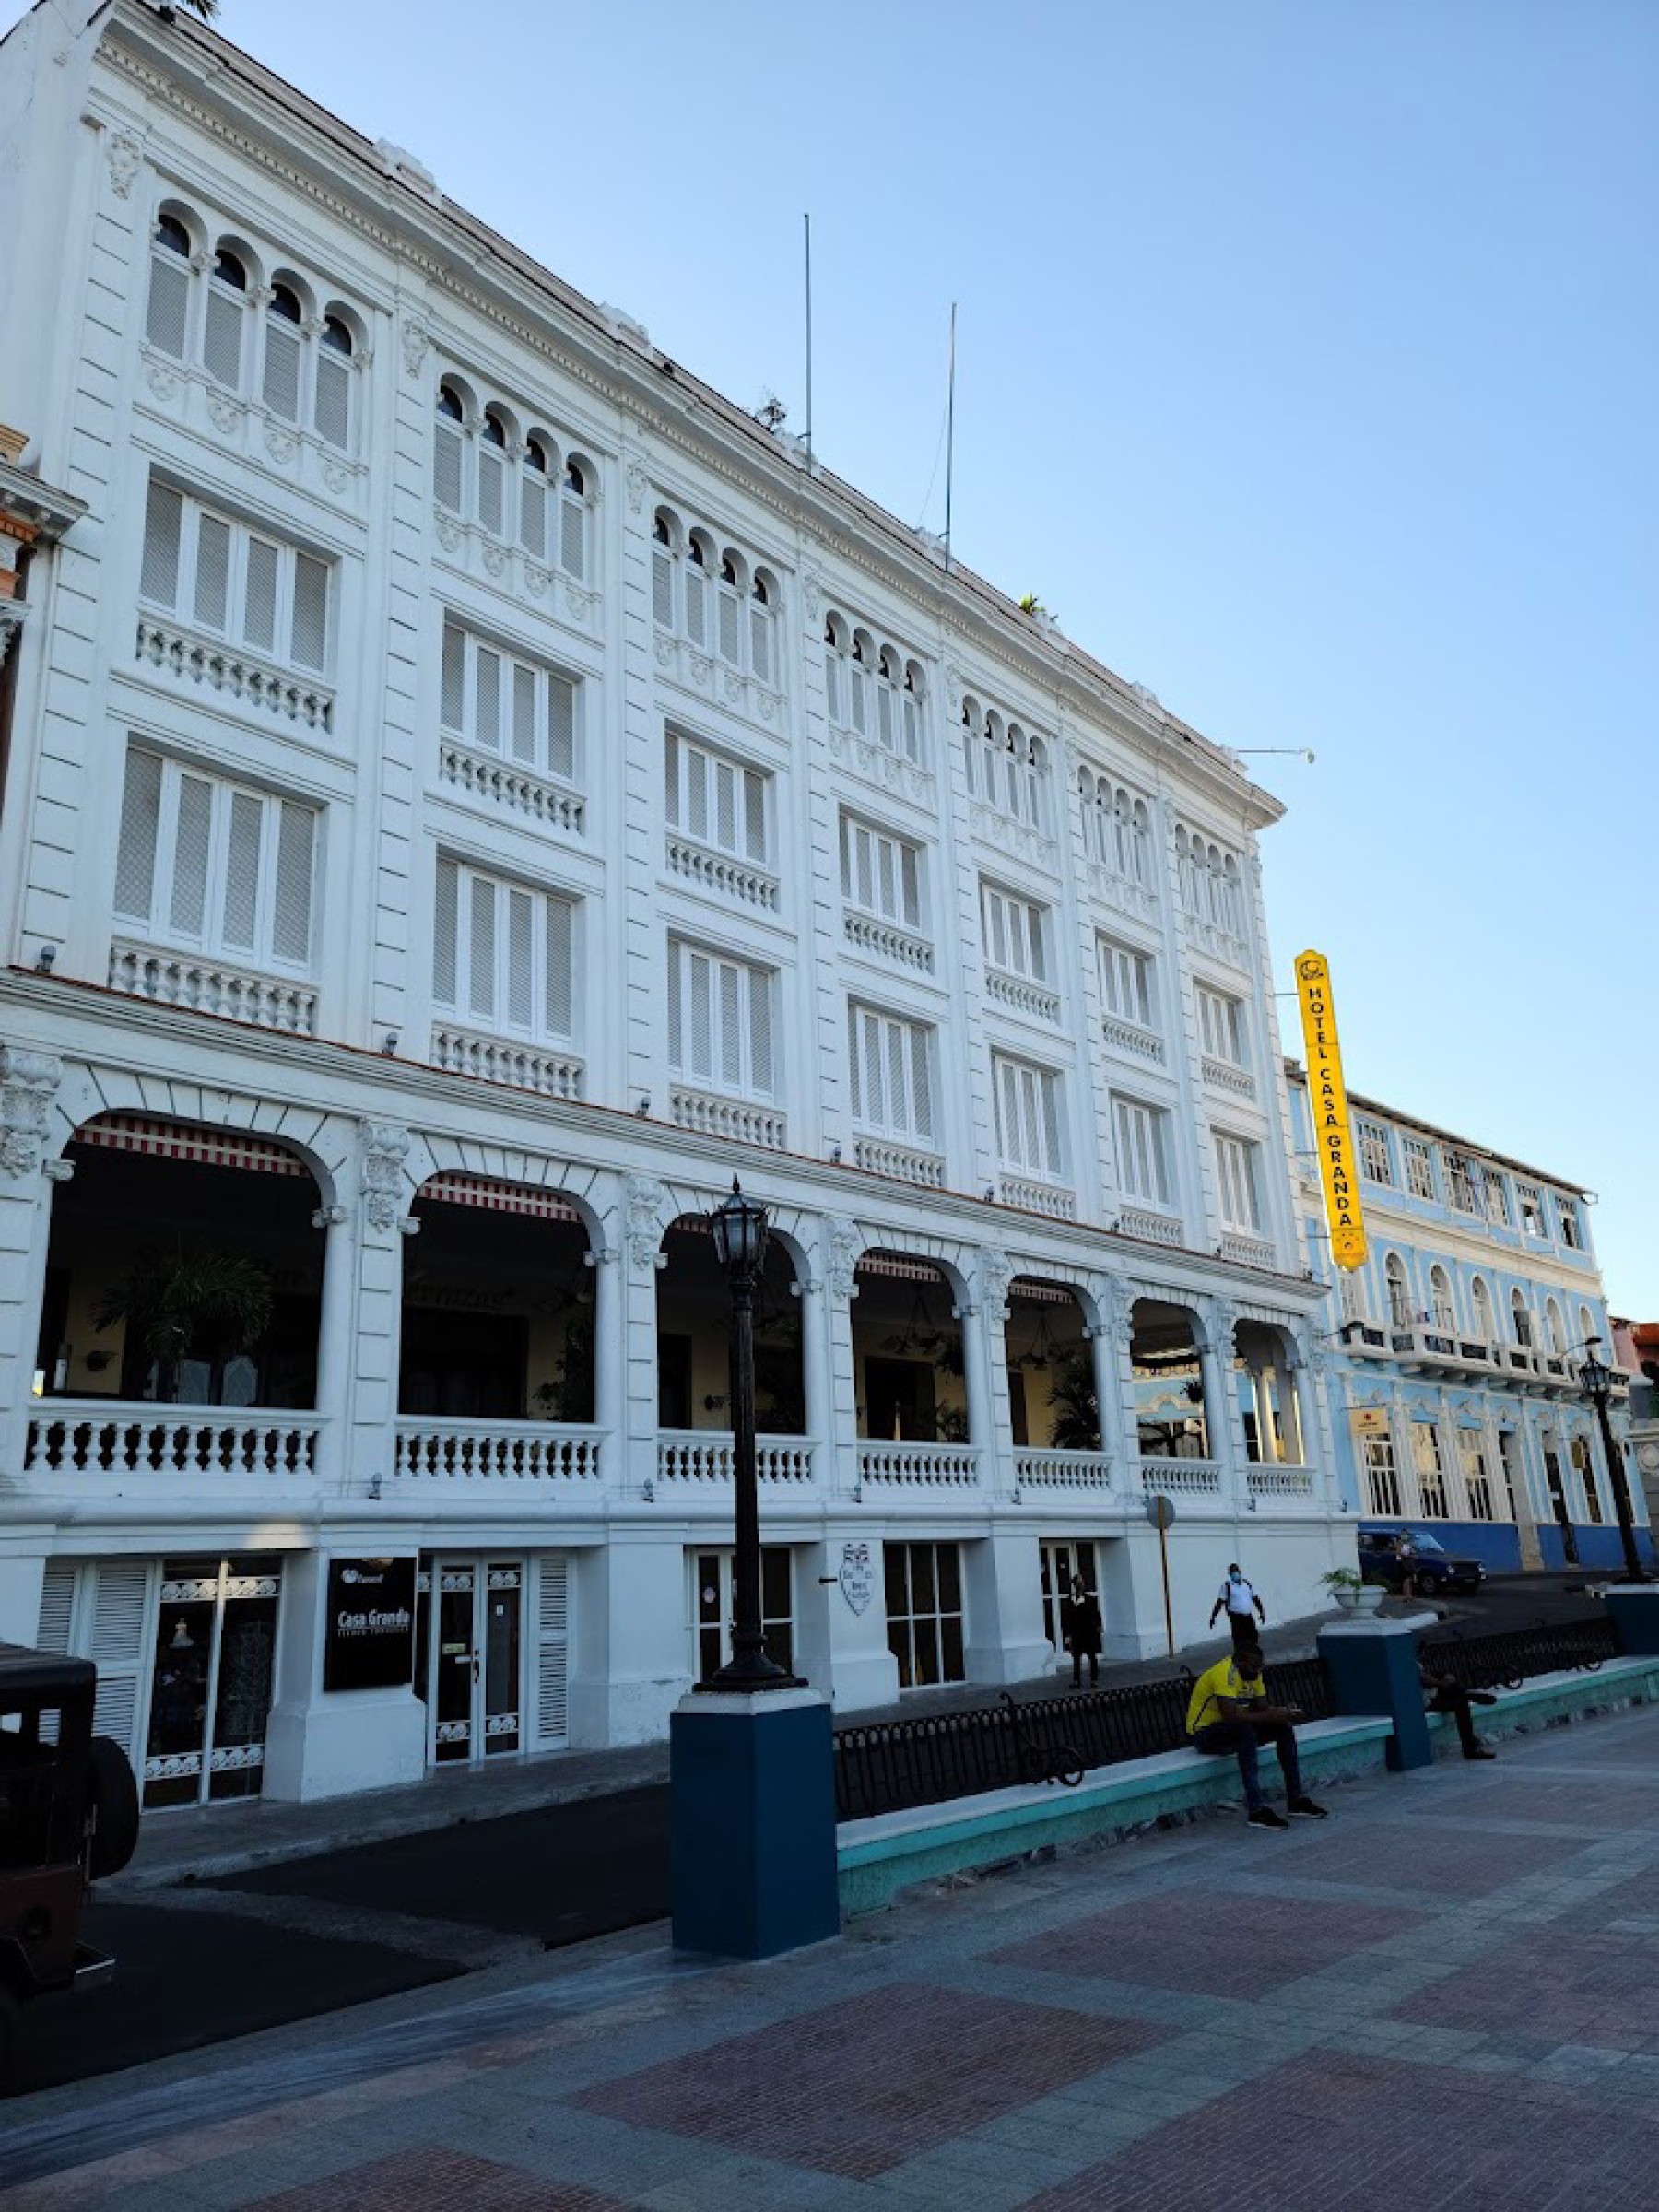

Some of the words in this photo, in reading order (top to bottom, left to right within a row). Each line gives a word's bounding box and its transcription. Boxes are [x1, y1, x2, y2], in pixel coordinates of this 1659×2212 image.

[1309, 987, 1328, 1059] HOTEL
[1320, 1067, 1338, 1126] CASA
[1327, 1135, 1352, 1226] GRANDA
[337, 1611, 367, 1628] Casa
